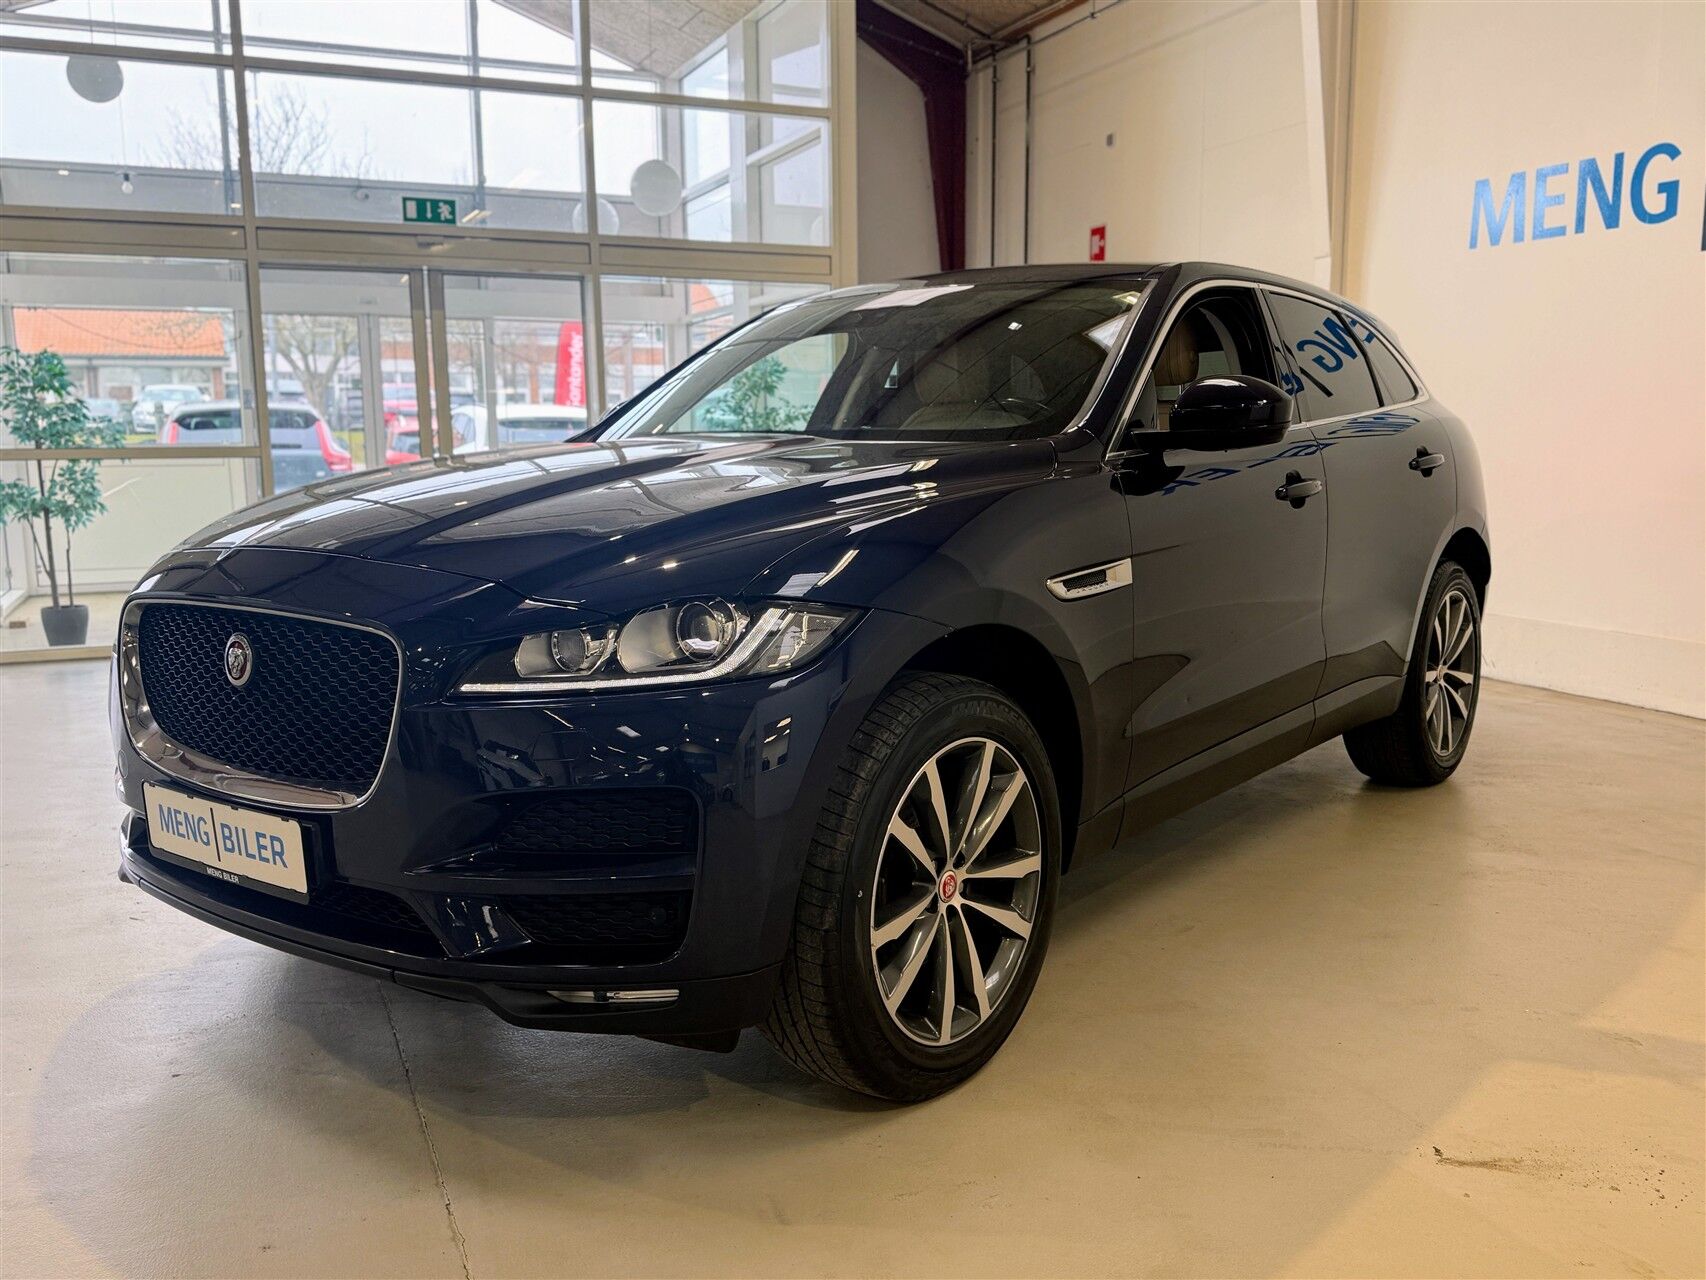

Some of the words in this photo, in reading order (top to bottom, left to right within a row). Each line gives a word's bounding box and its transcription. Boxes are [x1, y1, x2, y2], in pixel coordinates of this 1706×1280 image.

[1468, 142, 1682, 250] MENG
[158, 803, 211, 847] MENG
[219, 822, 289, 869] BILER
[206, 866, 223, 879] MENG
[223, 871, 240, 884] BILER
